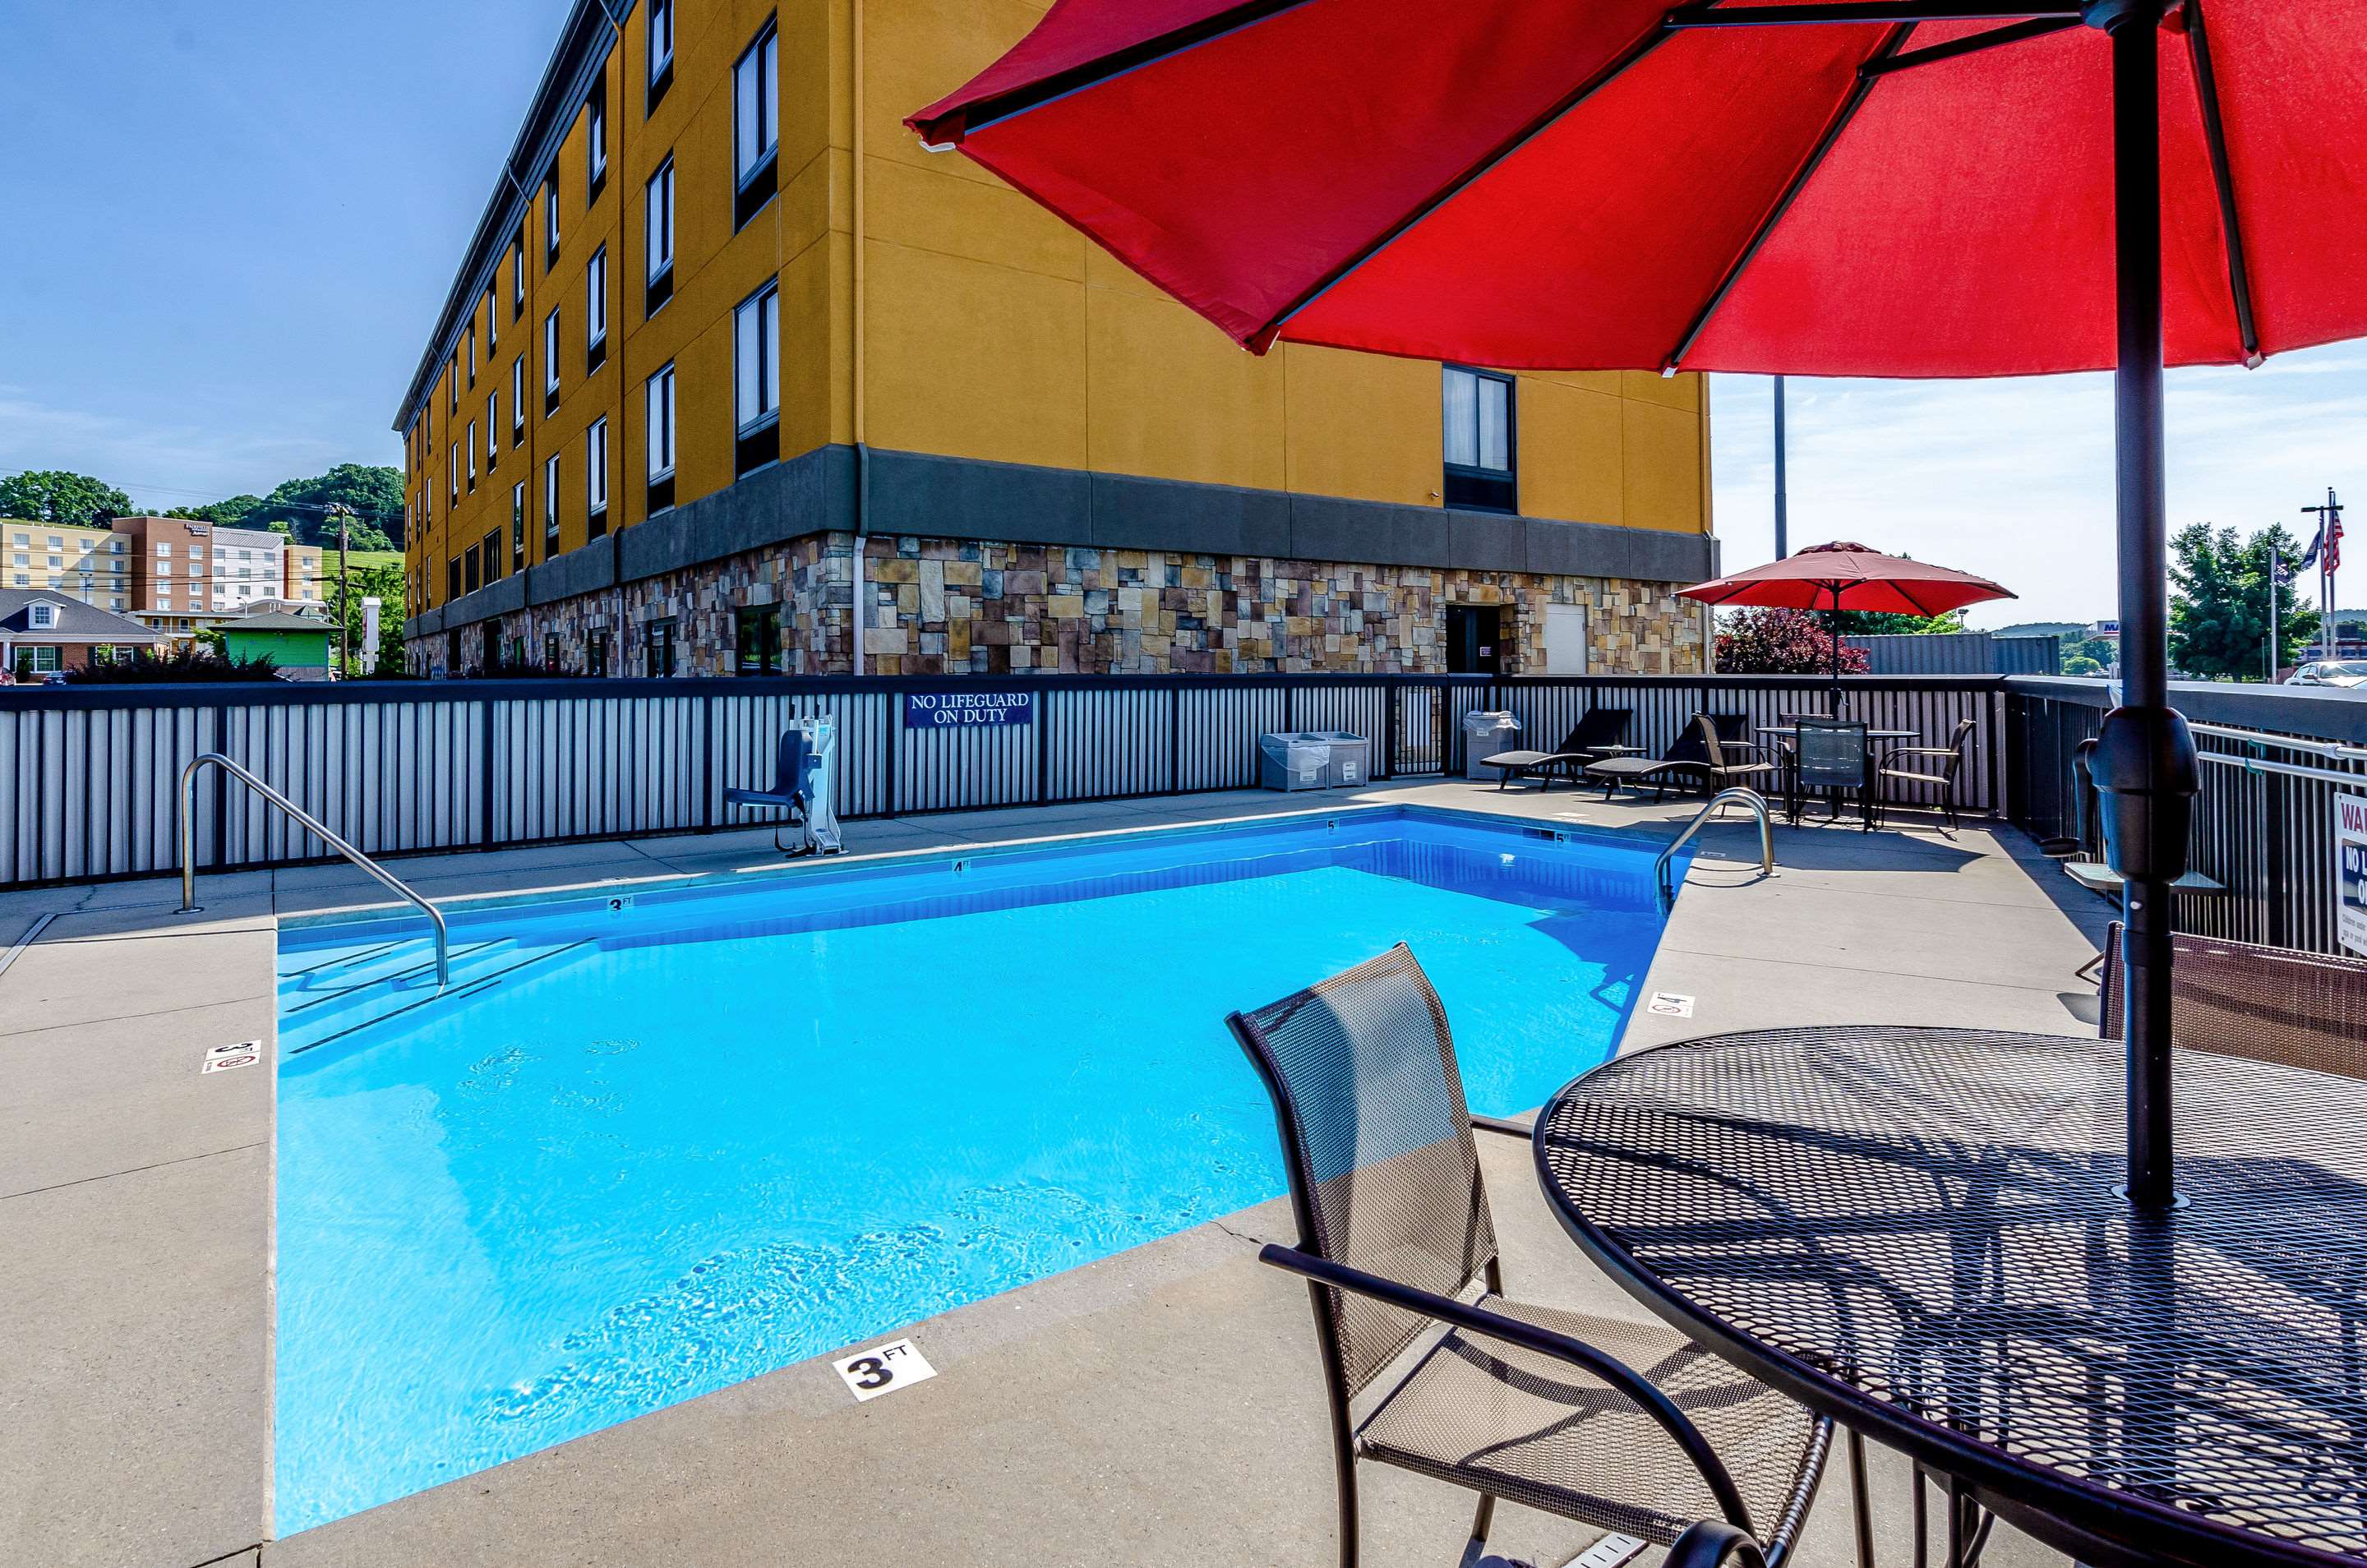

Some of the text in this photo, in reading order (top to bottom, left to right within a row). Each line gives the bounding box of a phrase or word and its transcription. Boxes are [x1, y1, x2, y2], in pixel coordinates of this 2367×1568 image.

[911, 693, 1029, 709] NO LIFEGUARD
[934, 708, 1008, 724] ON DUTY
[2341, 802, 2367, 835] WA
[2346, 846, 2360, 873] NO
[2358, 879, 2367, 906] O
[847, 1344, 907, 1390] 3 FT
